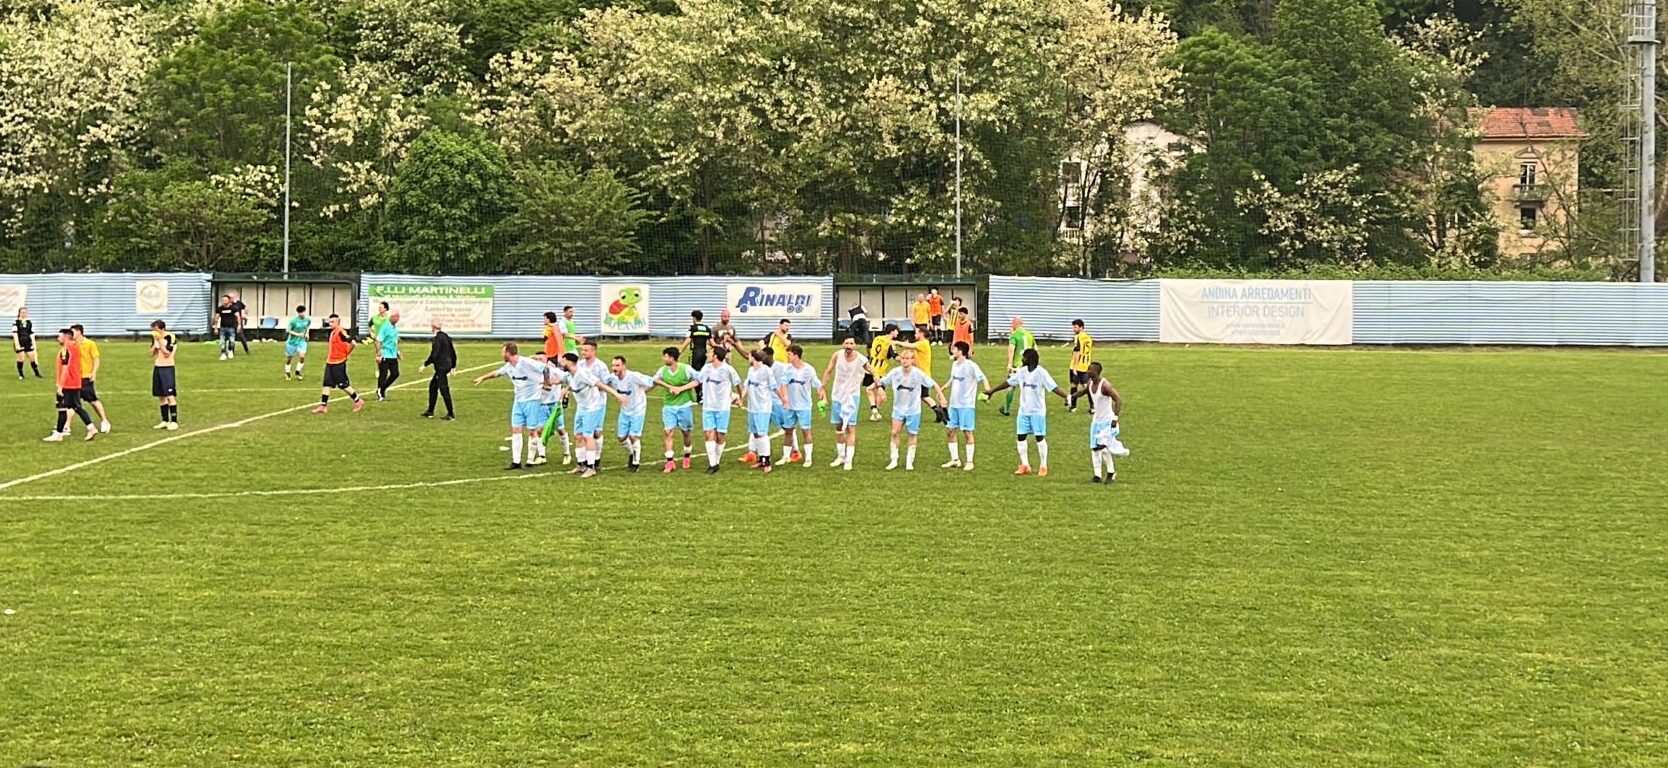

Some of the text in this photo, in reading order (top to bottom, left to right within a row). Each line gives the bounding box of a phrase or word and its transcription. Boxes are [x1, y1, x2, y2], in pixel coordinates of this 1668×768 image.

[409, 286, 485, 294] MARTINELLI
[1201, 287, 1312, 300] ANDINA ARREDAMENTI
[736, 286, 811, 308] RINALDI
[1208, 305, 1304, 318] INTERIOR DESIGN
[875, 344, 882, 356] 9
